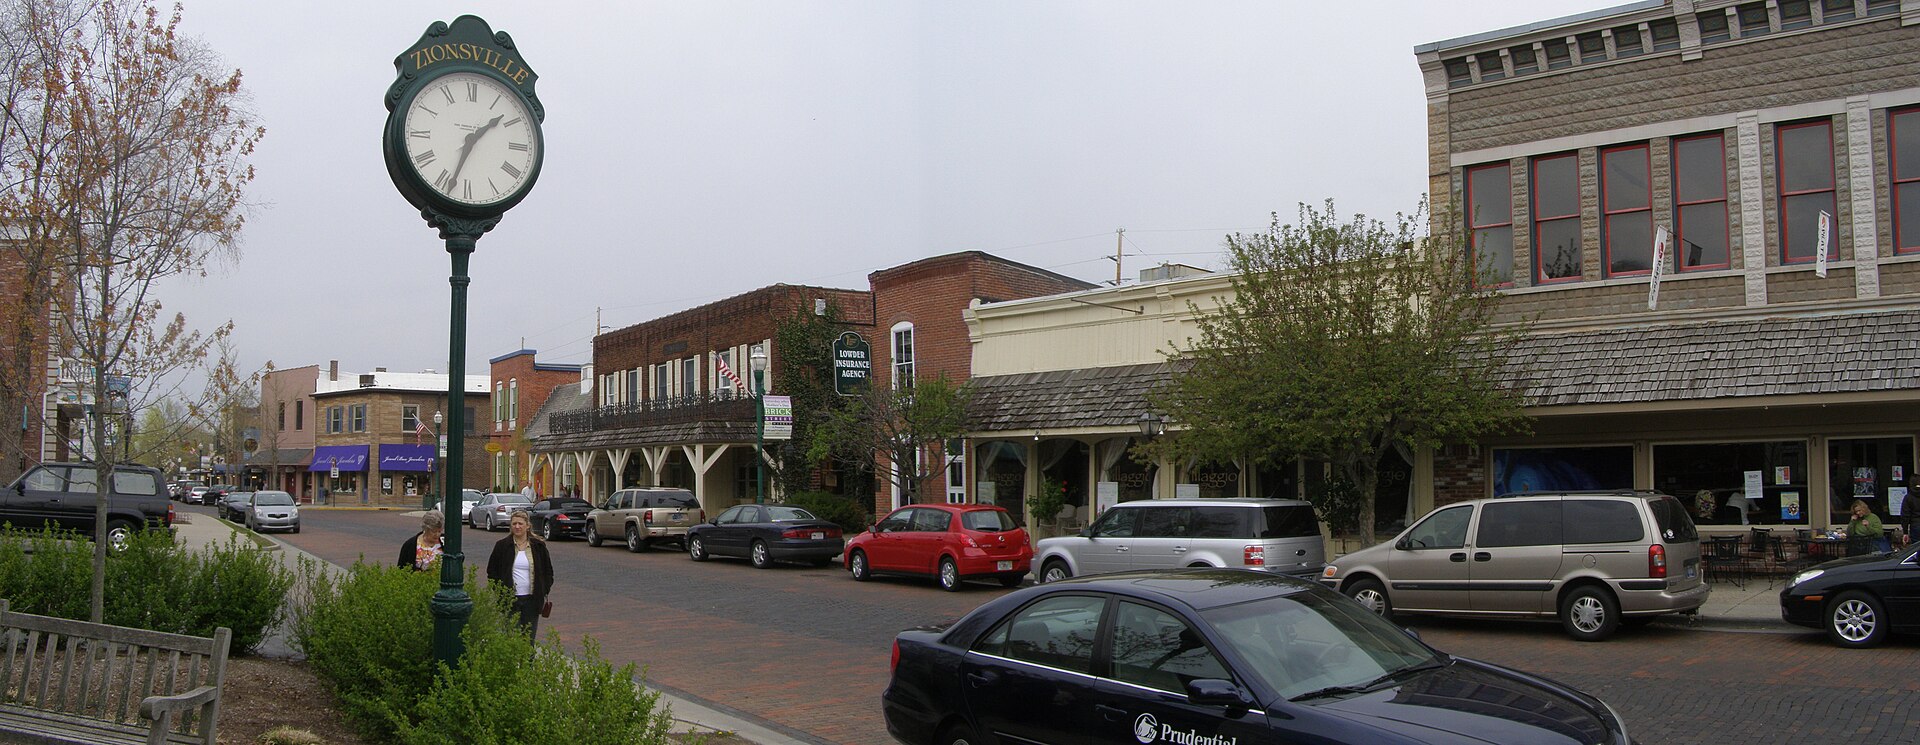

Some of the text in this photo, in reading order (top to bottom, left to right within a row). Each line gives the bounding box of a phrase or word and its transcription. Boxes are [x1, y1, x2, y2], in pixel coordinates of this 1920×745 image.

[410, 43, 529, 86] ZIONSVILLE
[466, 82, 478, 103] XII
[503, 117, 522, 128] II
[508, 142, 528, 152] III
[414, 149, 438, 169] VIII
[463, 179, 473, 200] VI
[839, 350, 865, 359] LOWDER
[835, 359, 870, 369] INSURANCE
[841, 369, 866, 378] AGENCY
